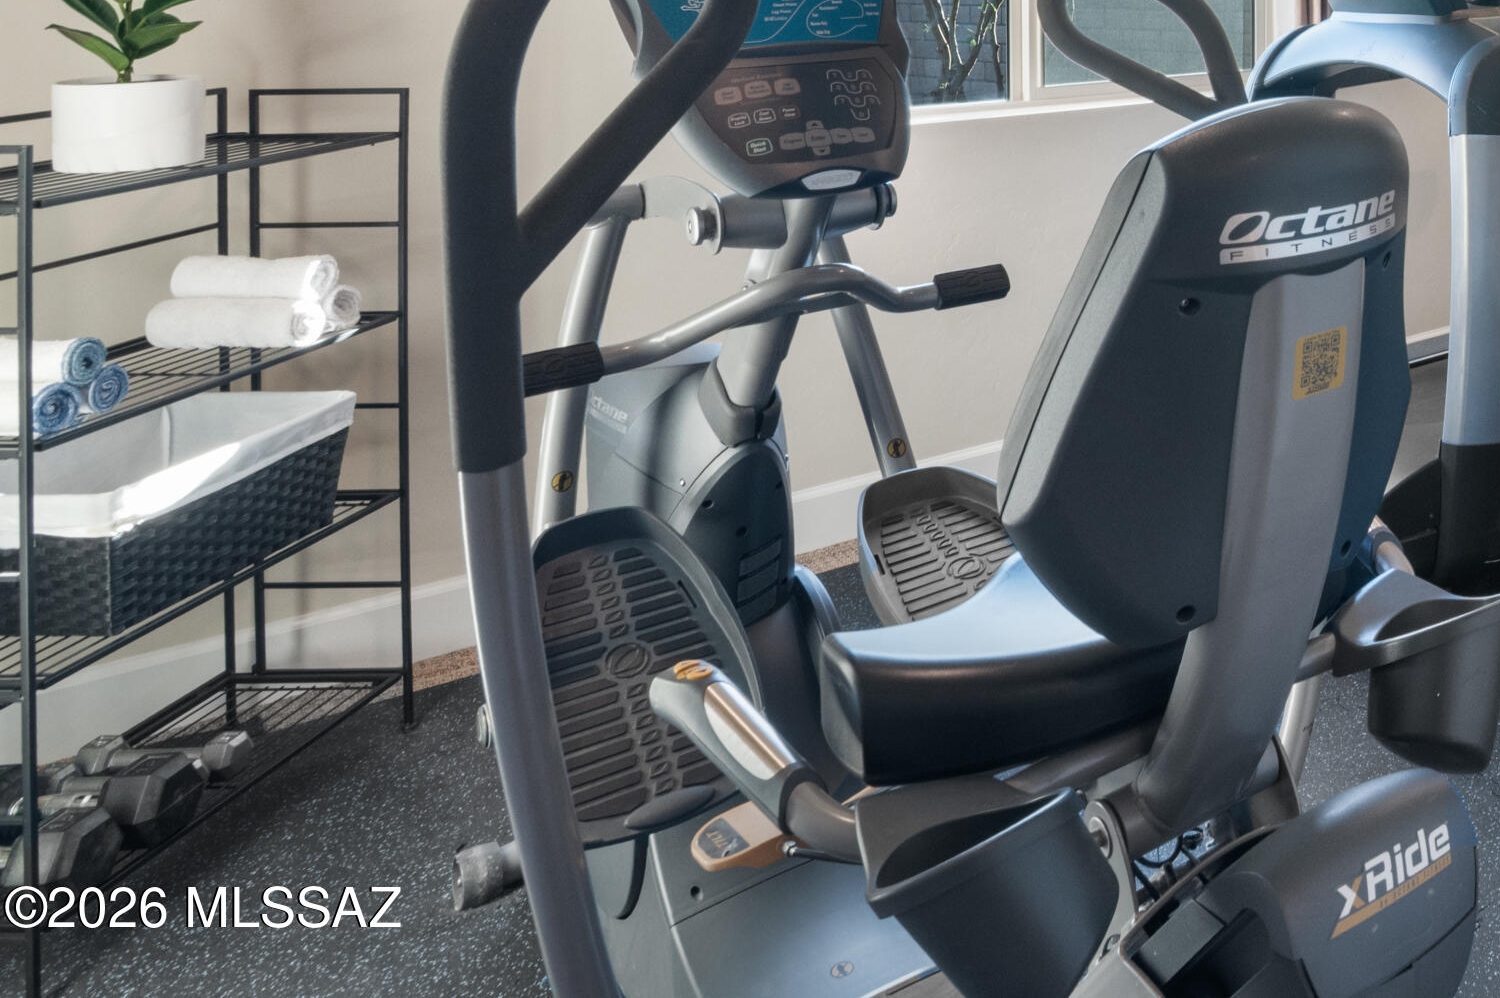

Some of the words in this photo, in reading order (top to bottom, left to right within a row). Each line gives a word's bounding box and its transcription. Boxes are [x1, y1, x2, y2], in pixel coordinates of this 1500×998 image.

[1219, 189, 1395, 245] Octane
[1229, 217, 1394, 261] FITNESS
[1337, 823, 1451, 920] xRide
